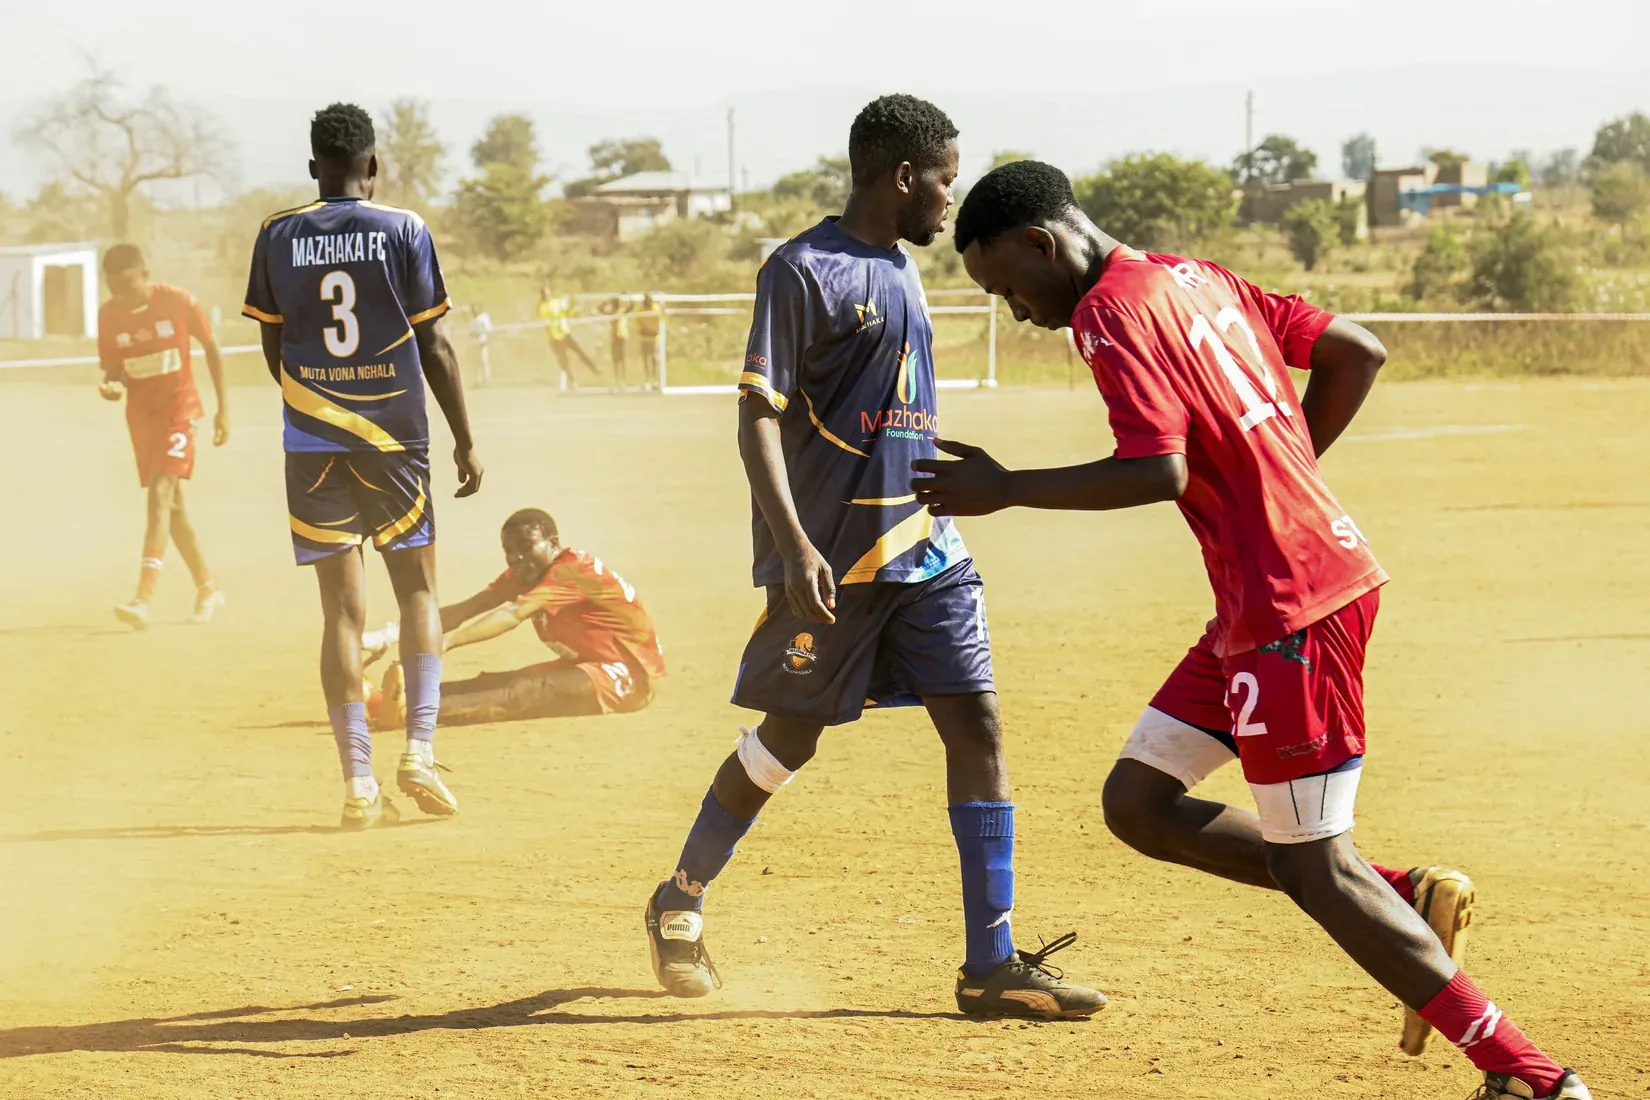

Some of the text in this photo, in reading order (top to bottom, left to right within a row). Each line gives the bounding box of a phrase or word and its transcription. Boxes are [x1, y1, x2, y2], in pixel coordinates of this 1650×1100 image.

[292, 231, 387, 267] MAZHAKA FC
[320, 270, 360, 358] 3
[300, 363, 396, 381] MUTA VONA NGHALA
[1190, 307, 1293, 431] 12
[167, 432, 188, 458] 2
[886, 428, 923, 440] Foundation
[667, 923, 690, 932] PUMA
